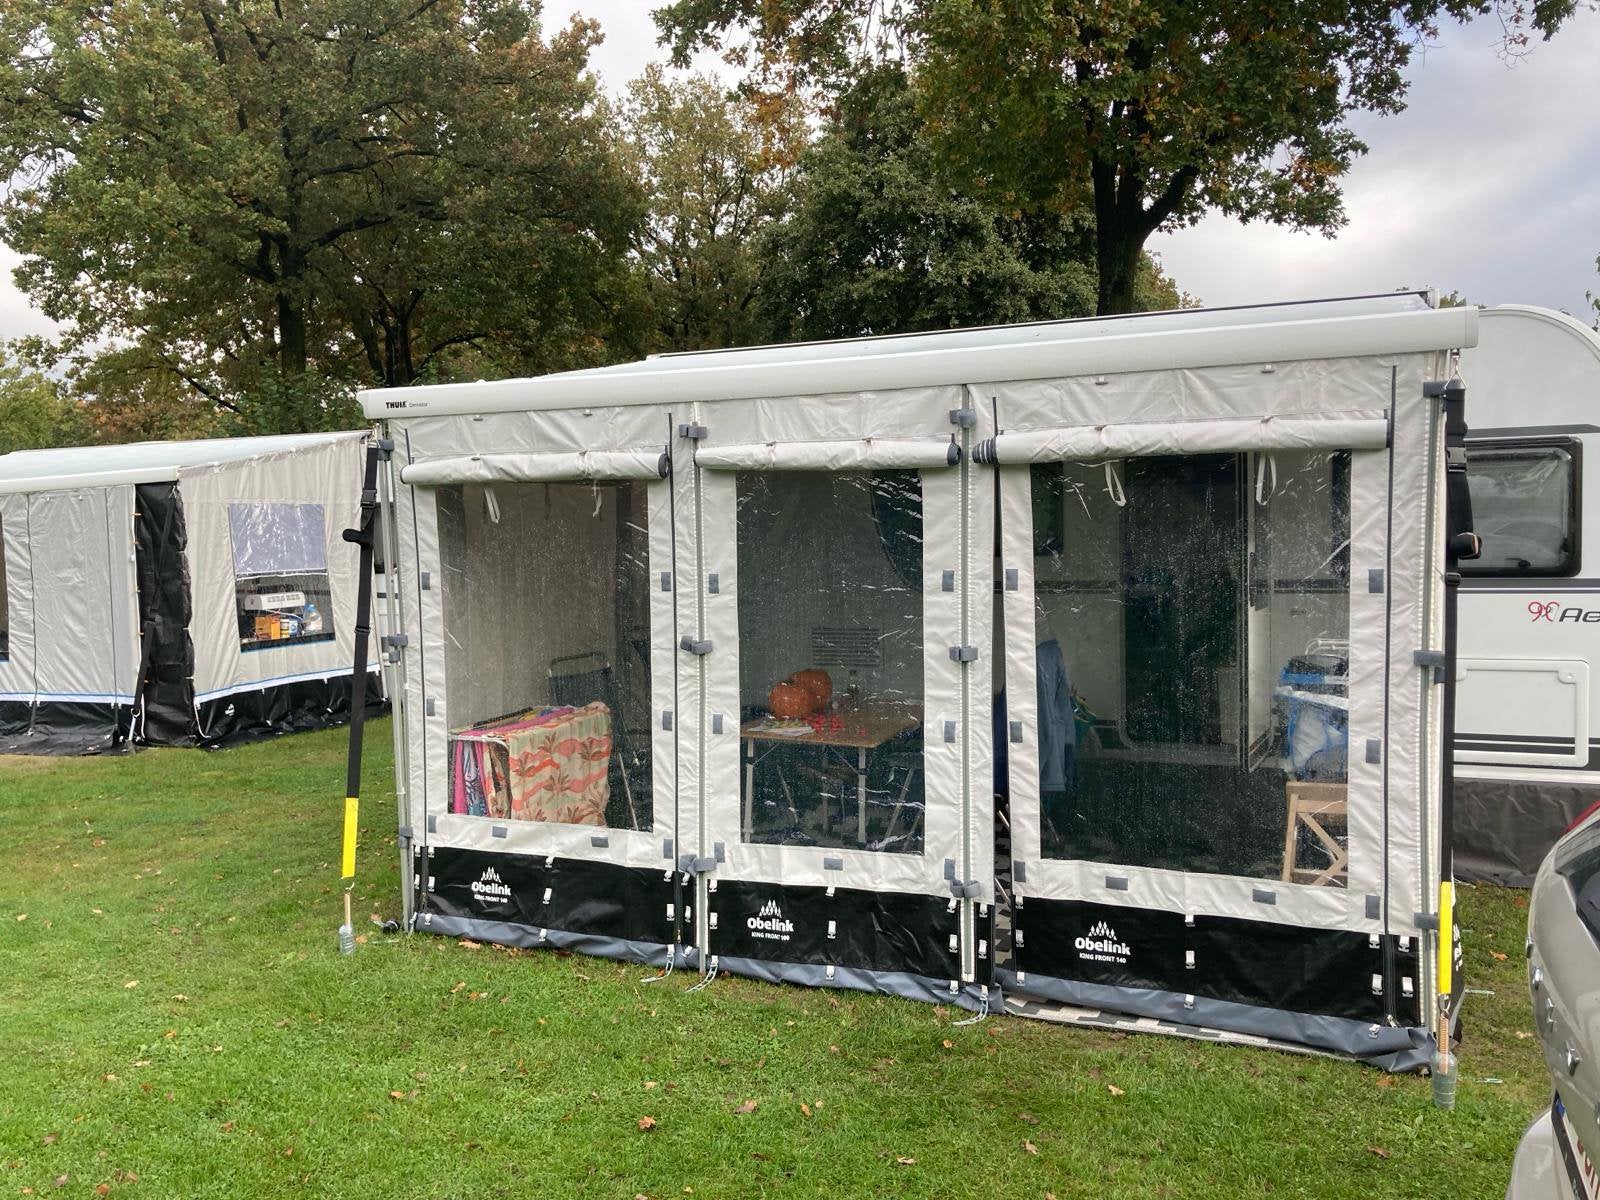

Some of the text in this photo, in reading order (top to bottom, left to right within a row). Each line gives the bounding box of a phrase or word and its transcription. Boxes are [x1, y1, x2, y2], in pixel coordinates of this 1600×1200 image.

[385, 400, 408, 409] THULE
[471, 881, 511, 896] Obelink
[747, 916, 794, 932] Obelink
[1074, 937, 1131, 956] Obelink
[1079, 952, 1127, 964] KING FRONT 140
